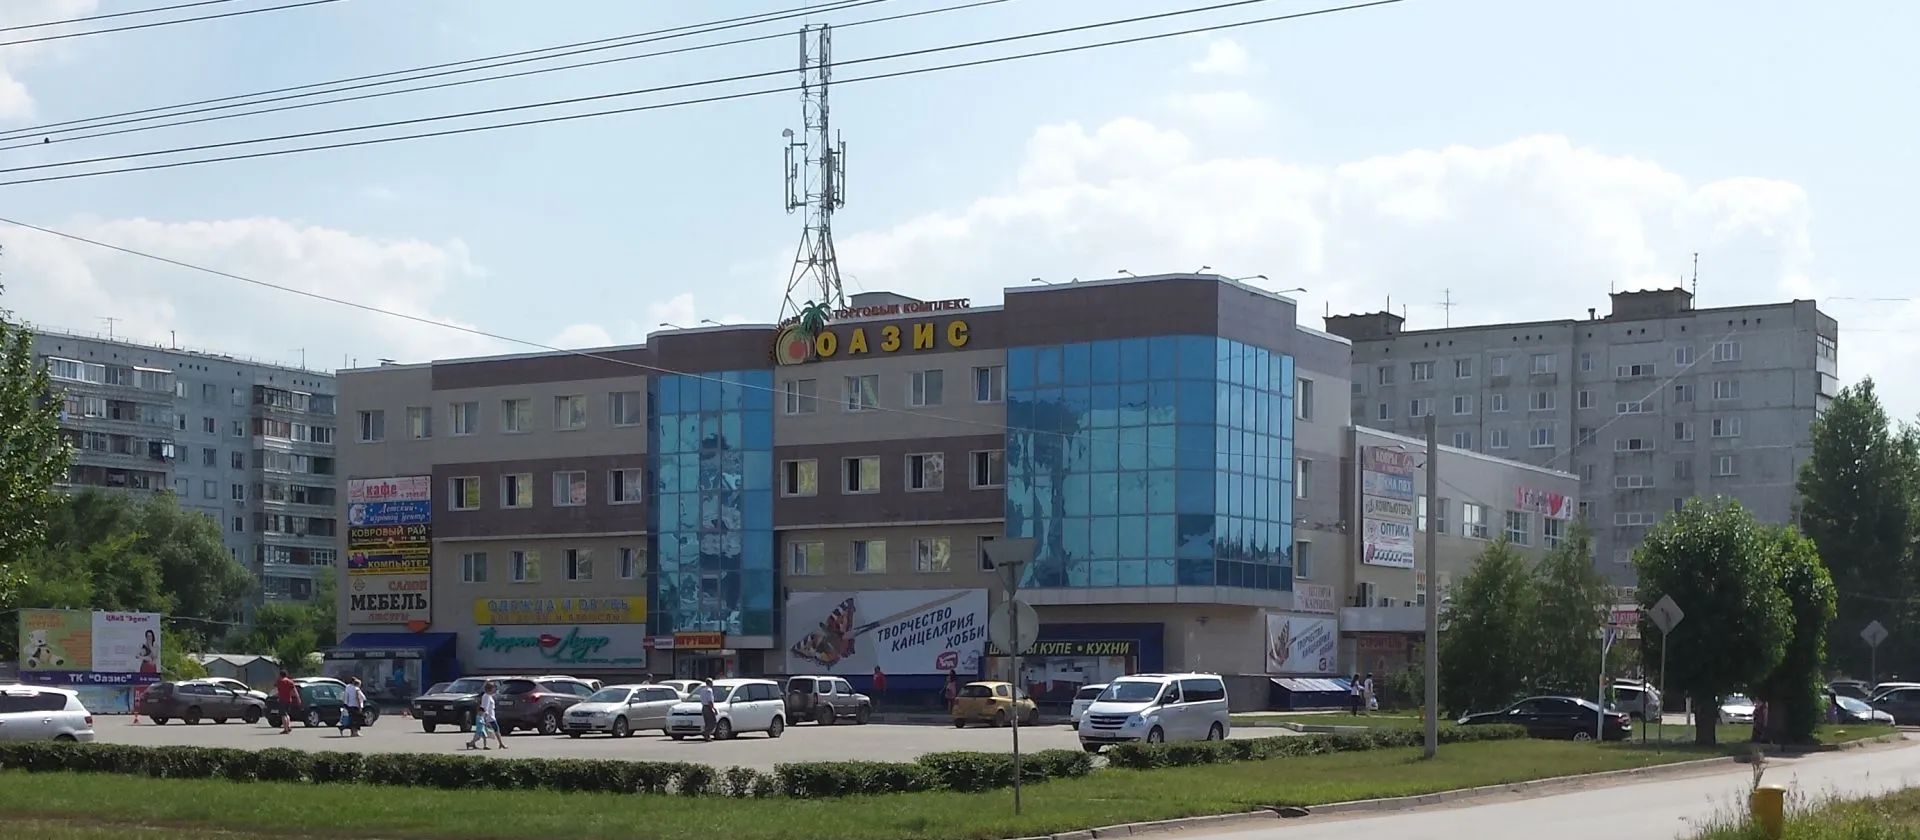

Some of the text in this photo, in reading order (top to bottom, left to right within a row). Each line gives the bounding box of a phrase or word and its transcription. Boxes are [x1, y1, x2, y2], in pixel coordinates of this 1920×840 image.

[833, 298, 970, 320] ТОРГОВЫЙ КОМПЛЕКС
[816, 320, 969, 358] ОАЗИС
[366, 481, 398, 498] кафе
[1375, 500, 1412, 516] КОМПЬЮТЕРЫ
[351, 524, 427, 537] КОВРОВЫЙ РАЙ
[1380, 523, 1410, 537] ОПТИКА
[368, 559, 429, 569] КОМПЬЮТЕР
[351, 593, 427, 611] МЕБЕЛЬ
[487, 598, 630, 612] ОДЕЖДА И ОБУВЬ
[878, 607, 952, 642] ТВОРЧЕСТВО
[891, 613, 974, 652] КАНЦЕЛЯРИЯ
[675, 635, 720, 646] ИГРУШКИ
[945, 625, 985, 649] ХОББИ
[1040, 642, 1072, 654] КУПЕ
[1086, 642, 1130, 654] КУХНИ
[68, 673, 84, 683] ТК
[89, 673, 132, 683] "Оазис"
